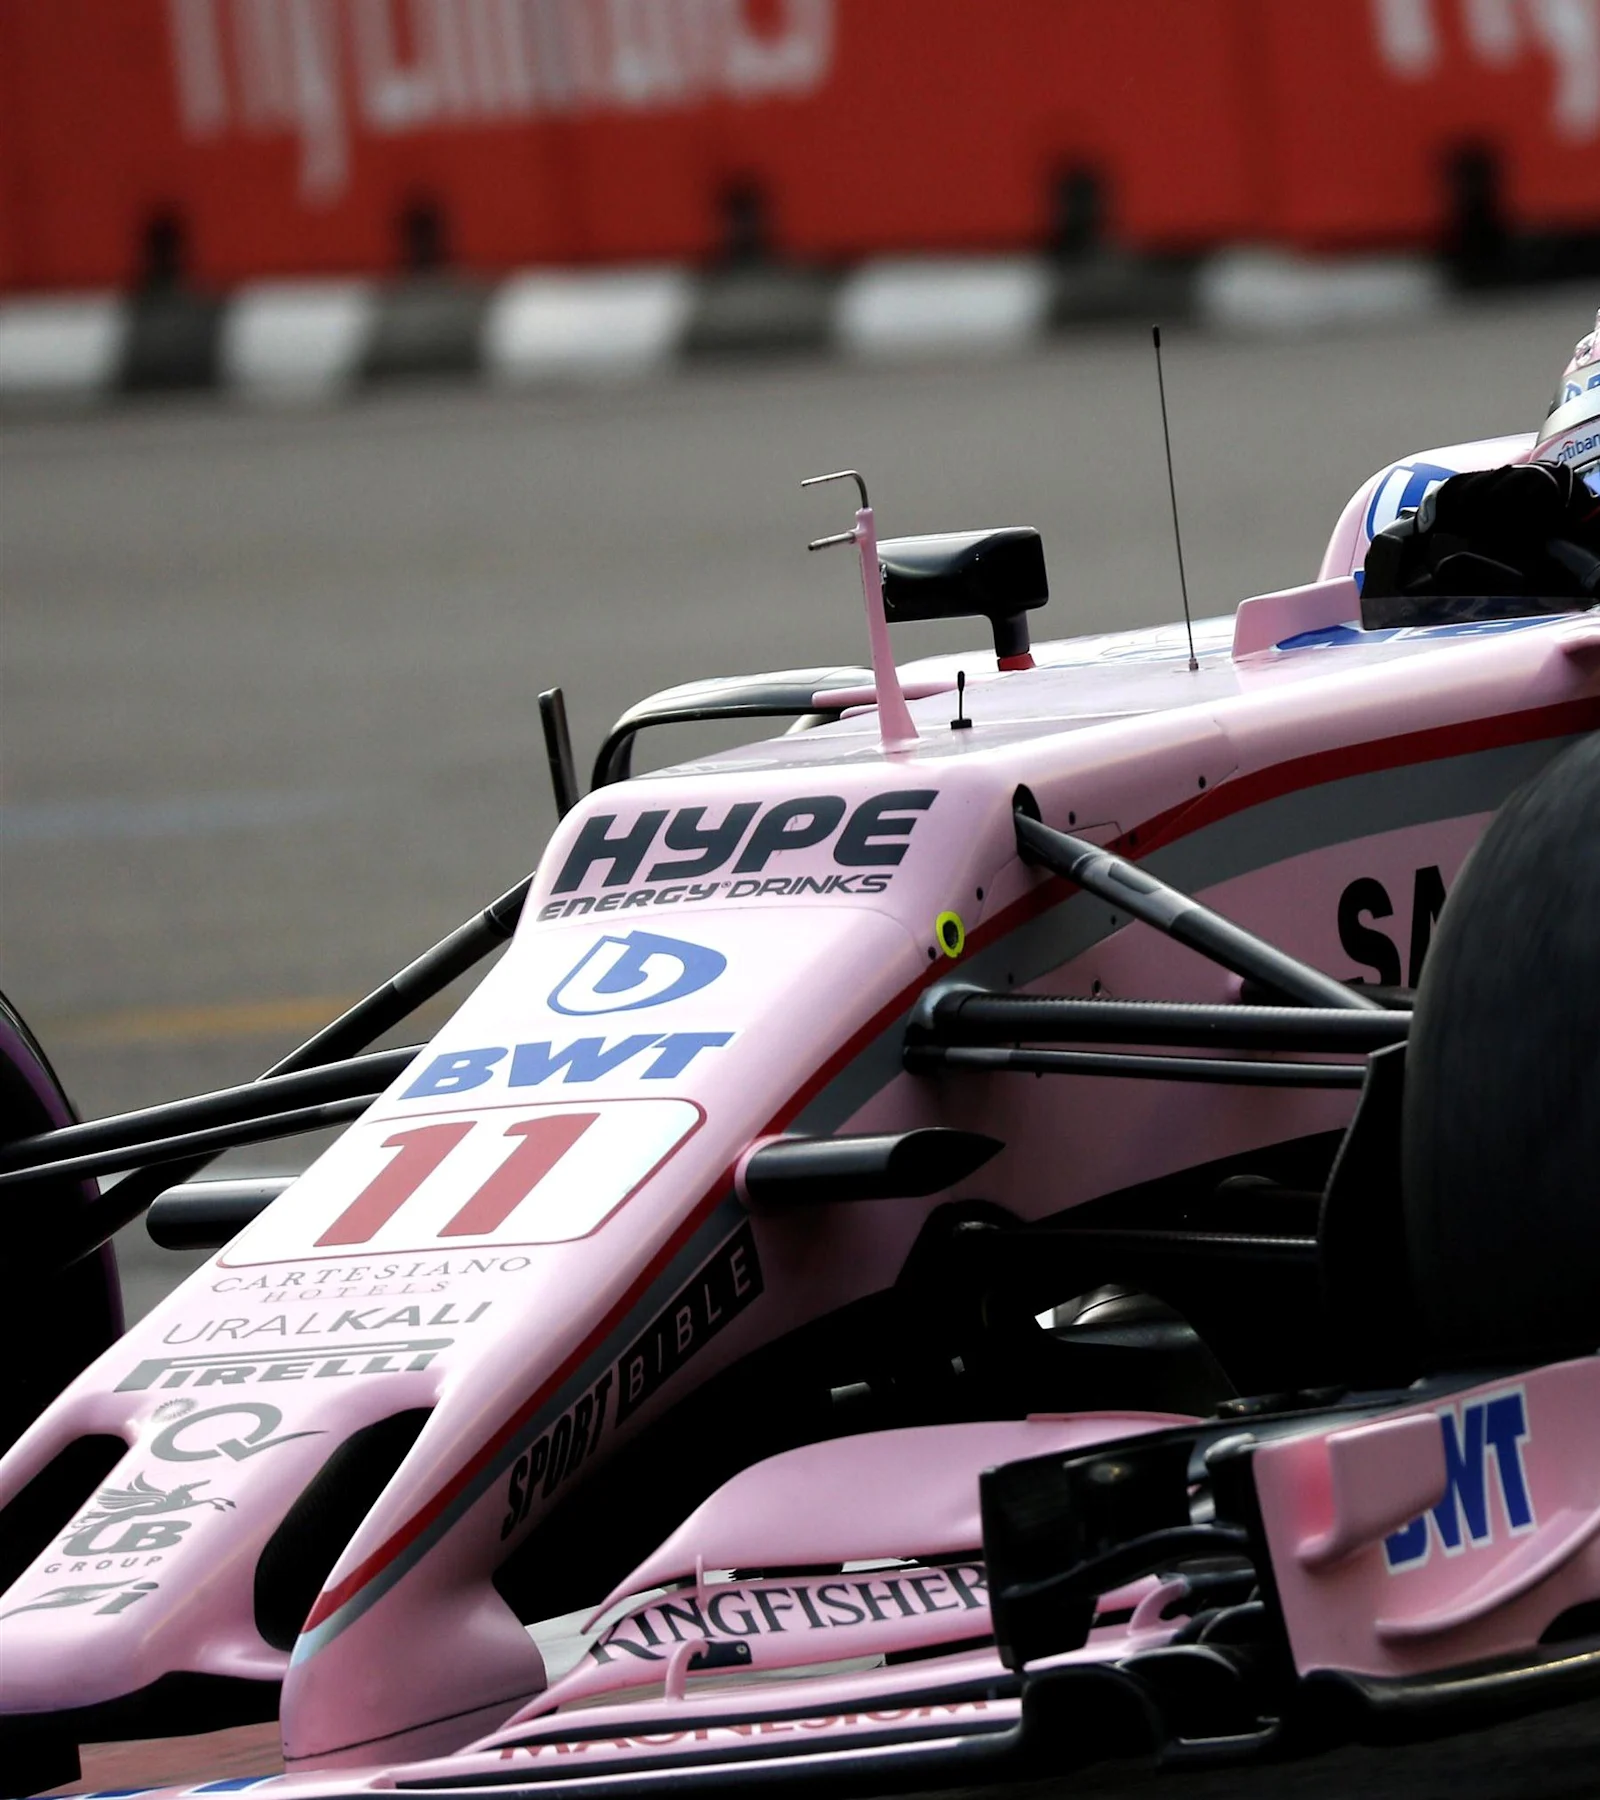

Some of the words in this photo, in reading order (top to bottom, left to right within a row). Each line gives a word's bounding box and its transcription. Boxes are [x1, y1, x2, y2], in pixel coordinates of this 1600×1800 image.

[550, 790, 940, 895] HYPE
[729, 874, 894, 897] DRINKS
[398, 1031, 736, 1100] BWT
[313, 1111, 602, 1248] 11
[211, 1256, 533, 1293] CARTESIANO
[258, 1280, 451, 1303] HOTELS
[163, 1301, 493, 1346] URALKALI
[112, 1338, 456, 1393] PIRELLI
[44, 1555, 163, 1574] GROUP
